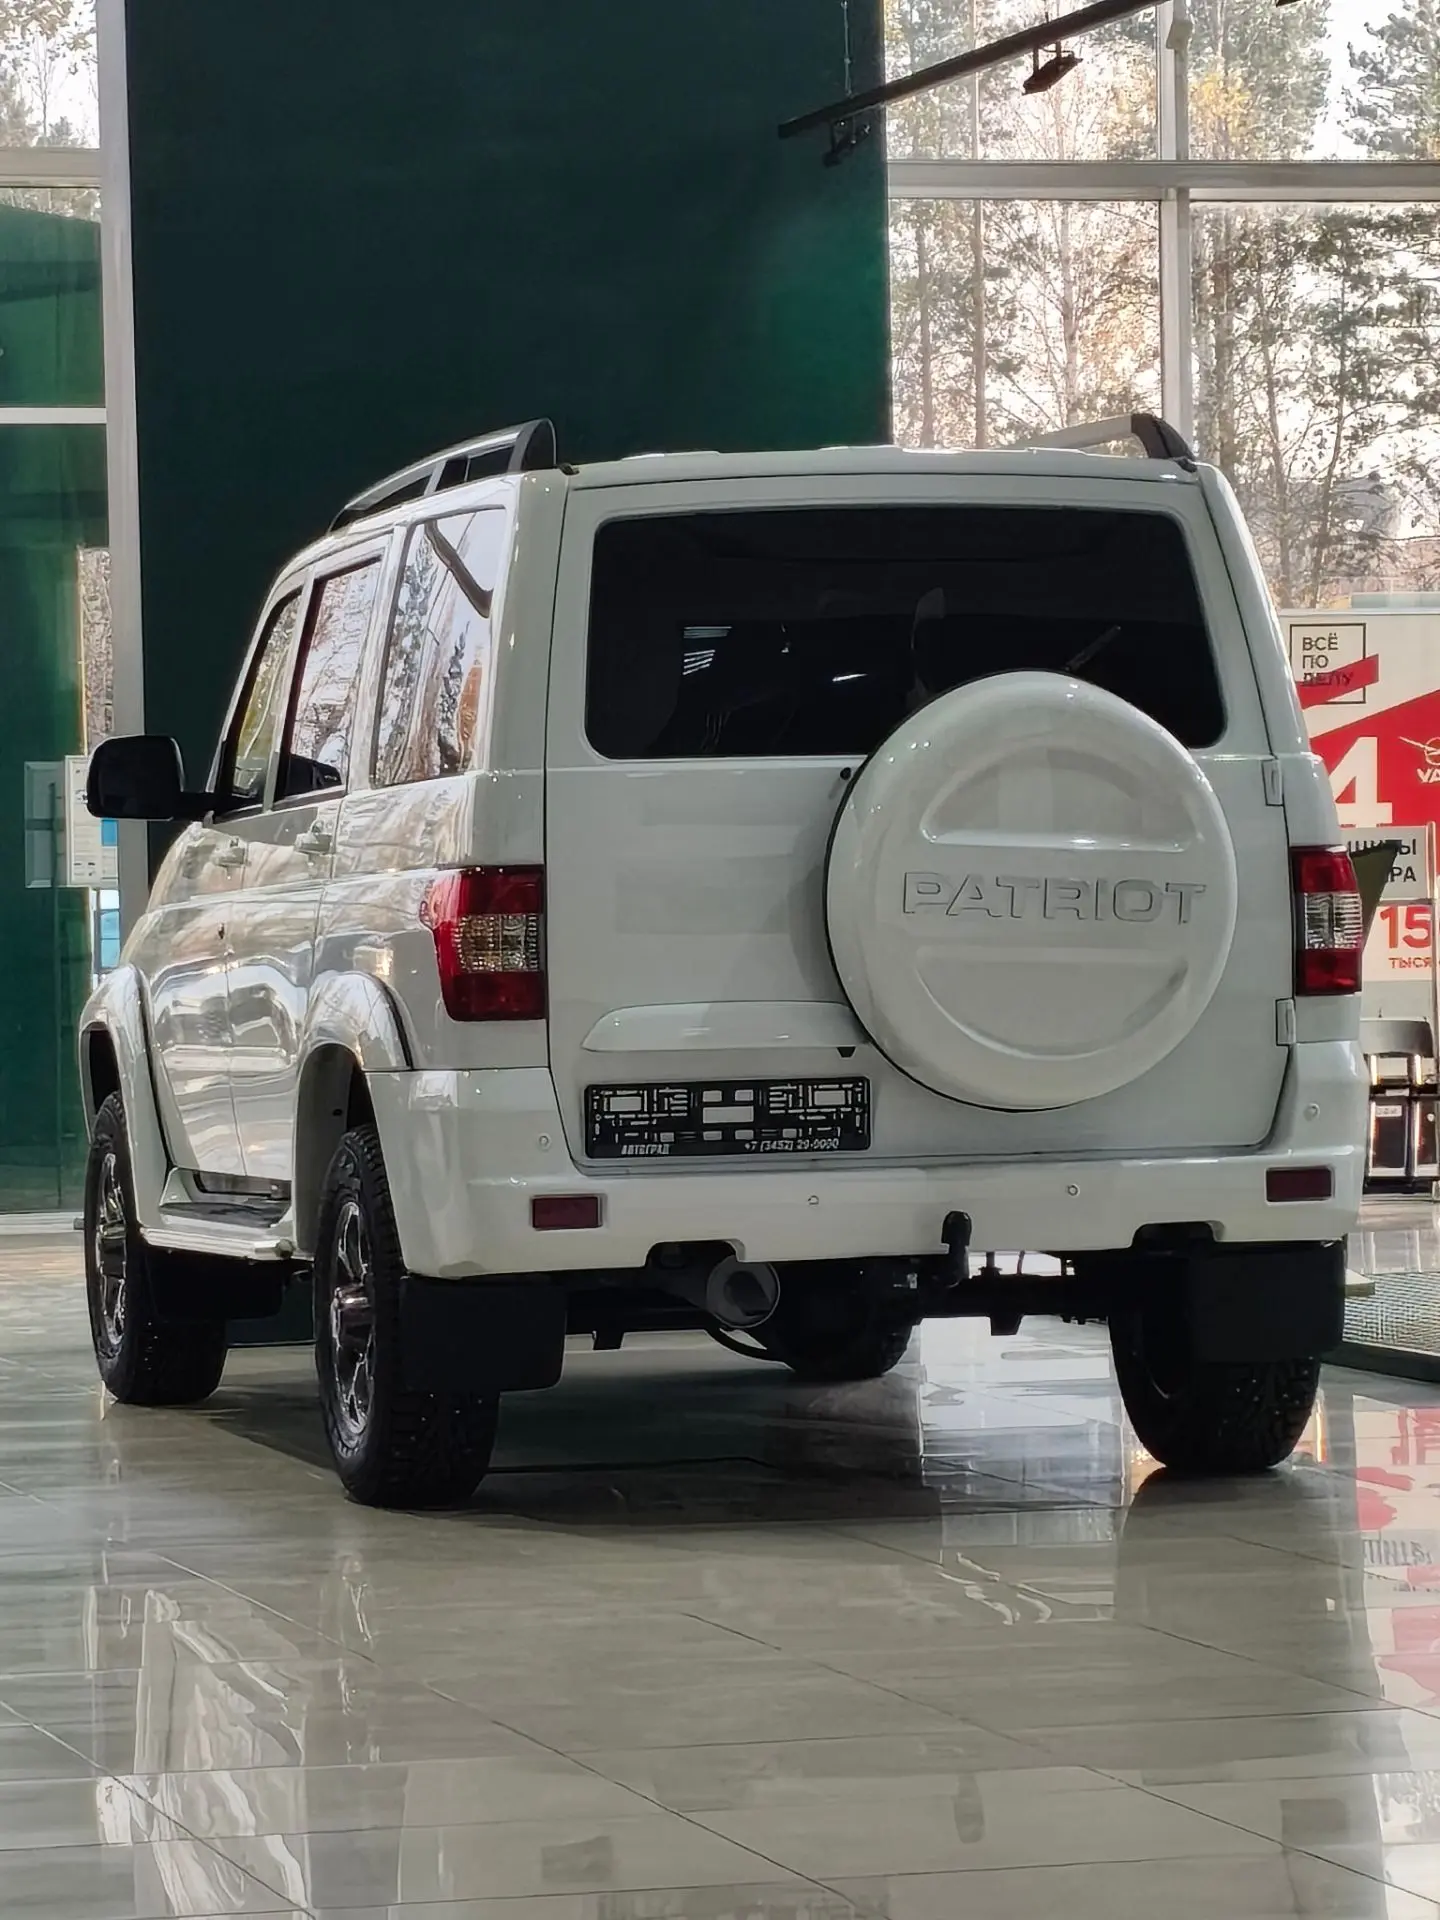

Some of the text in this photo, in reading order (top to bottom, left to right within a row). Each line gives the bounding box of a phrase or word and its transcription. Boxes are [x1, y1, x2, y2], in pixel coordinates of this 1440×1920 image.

[1302, 632, 1339, 651] ВСЁ
[1302, 655, 1329, 669] ПО
[903, 871, 1207, 925] PATRIOT
